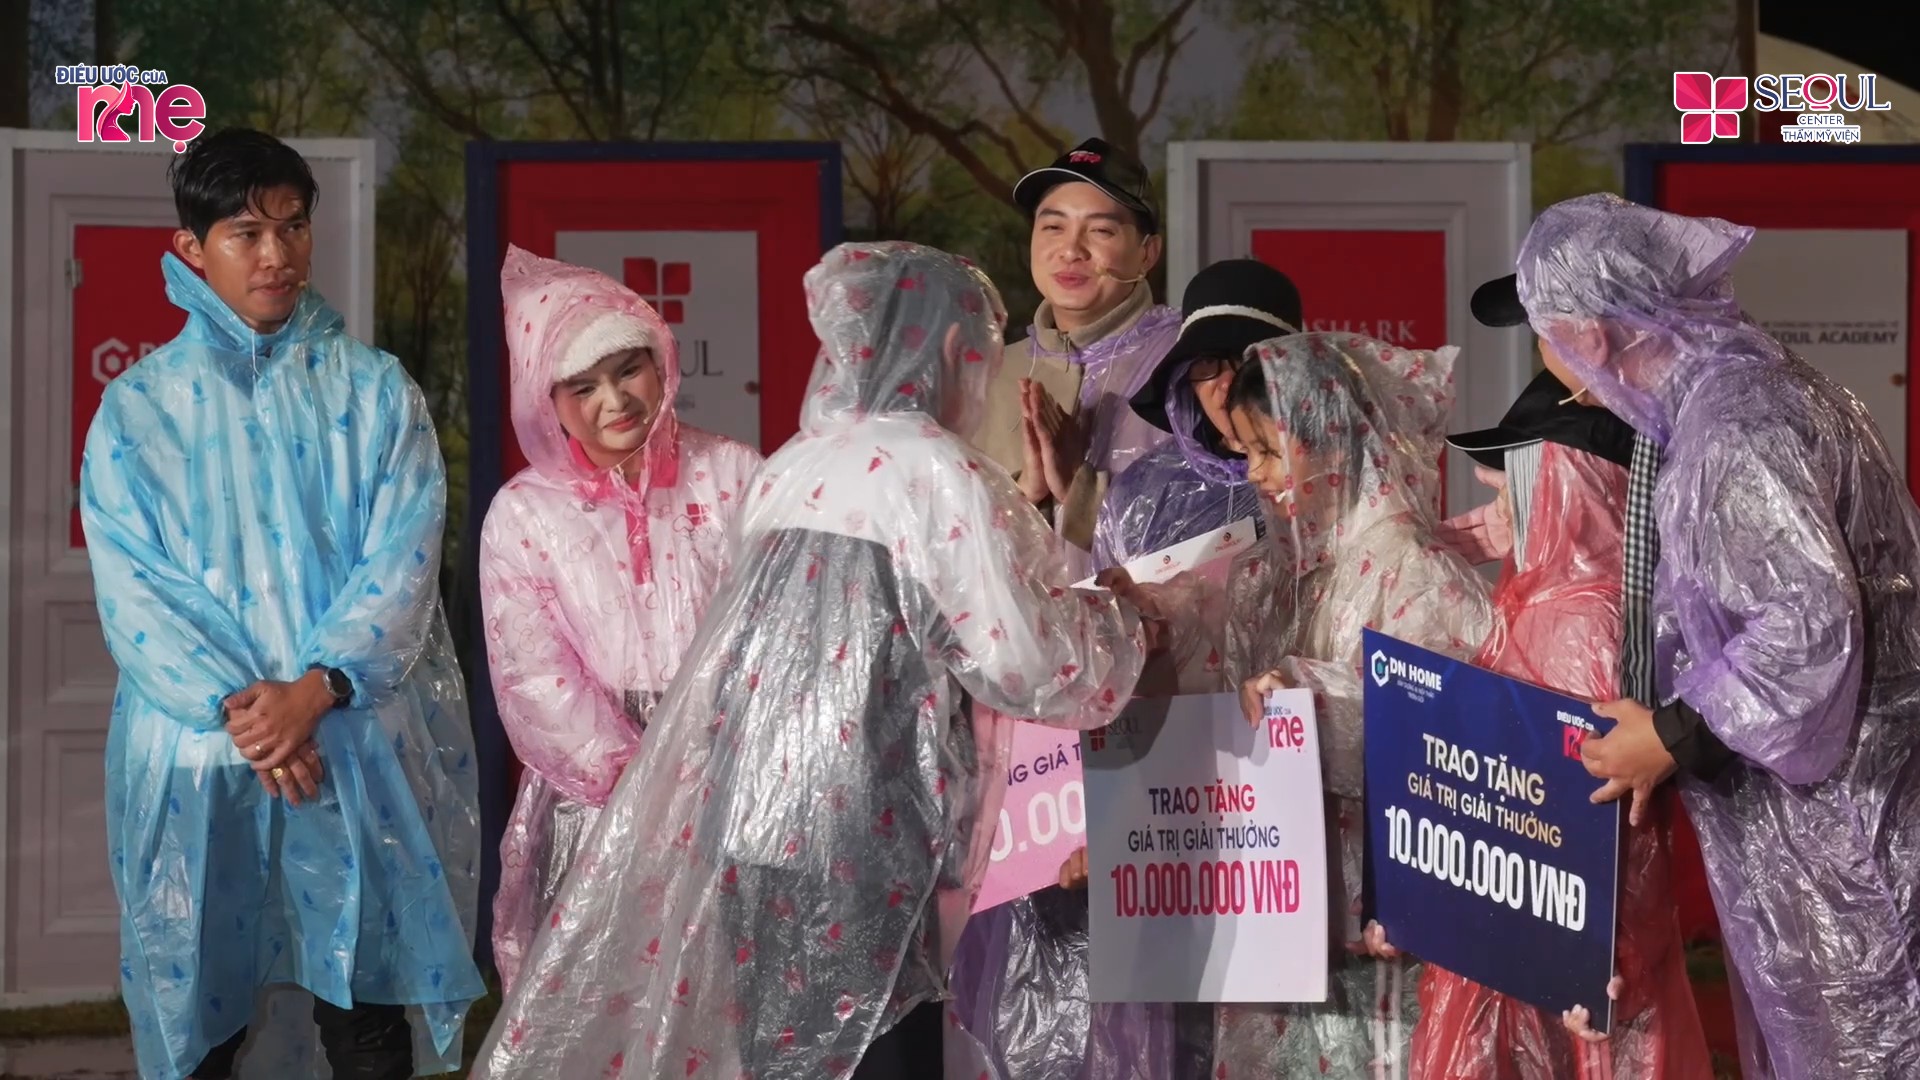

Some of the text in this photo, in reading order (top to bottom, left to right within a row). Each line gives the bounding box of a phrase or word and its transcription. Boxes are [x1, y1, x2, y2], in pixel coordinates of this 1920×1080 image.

[1818, 331, 1899, 344] ACADEMY
[1390, 657, 1406, 678] DN
[1409, 664, 1442, 692] HOME
[1268, 716, 1304, 753] mẹ
[1034, 744, 1069, 775] GIÁ
[1422, 732, 1546, 806] TRAO TẶNG
[1149, 779, 1255, 821] TRAO TẶNG
[1408, 772, 1562, 848] GIÁ TRỊ GIẢI THƯỞNG
[1128, 819, 1280, 857] GIÁ TRỊ GIẢI THƯỞNG
[1111, 860, 1300, 917] 10.000.000 VNĐ
[1385, 805, 1587, 932] 10.000.000 VNĐ
